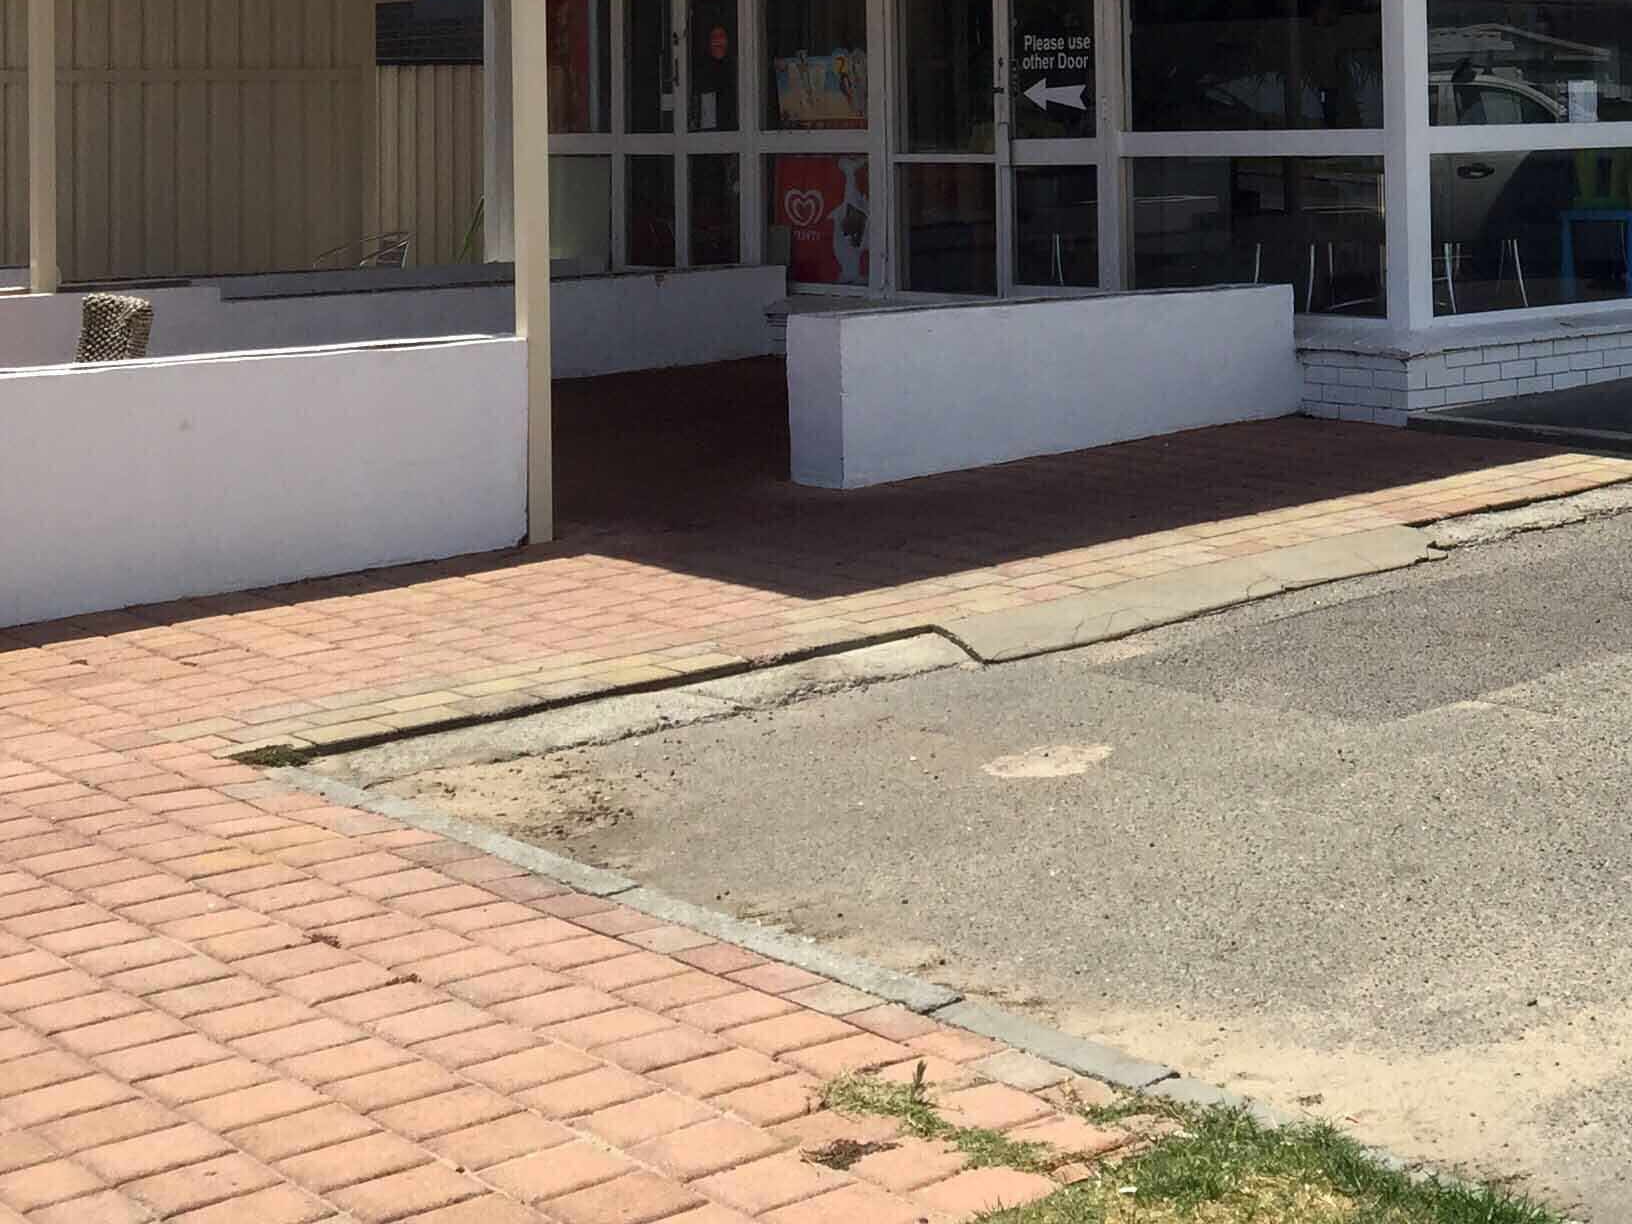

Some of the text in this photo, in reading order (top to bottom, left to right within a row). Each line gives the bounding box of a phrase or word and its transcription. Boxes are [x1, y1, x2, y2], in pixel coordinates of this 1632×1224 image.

[1024, 34, 1091, 51] Please use
[1022, 52, 1089, 70] other Door
